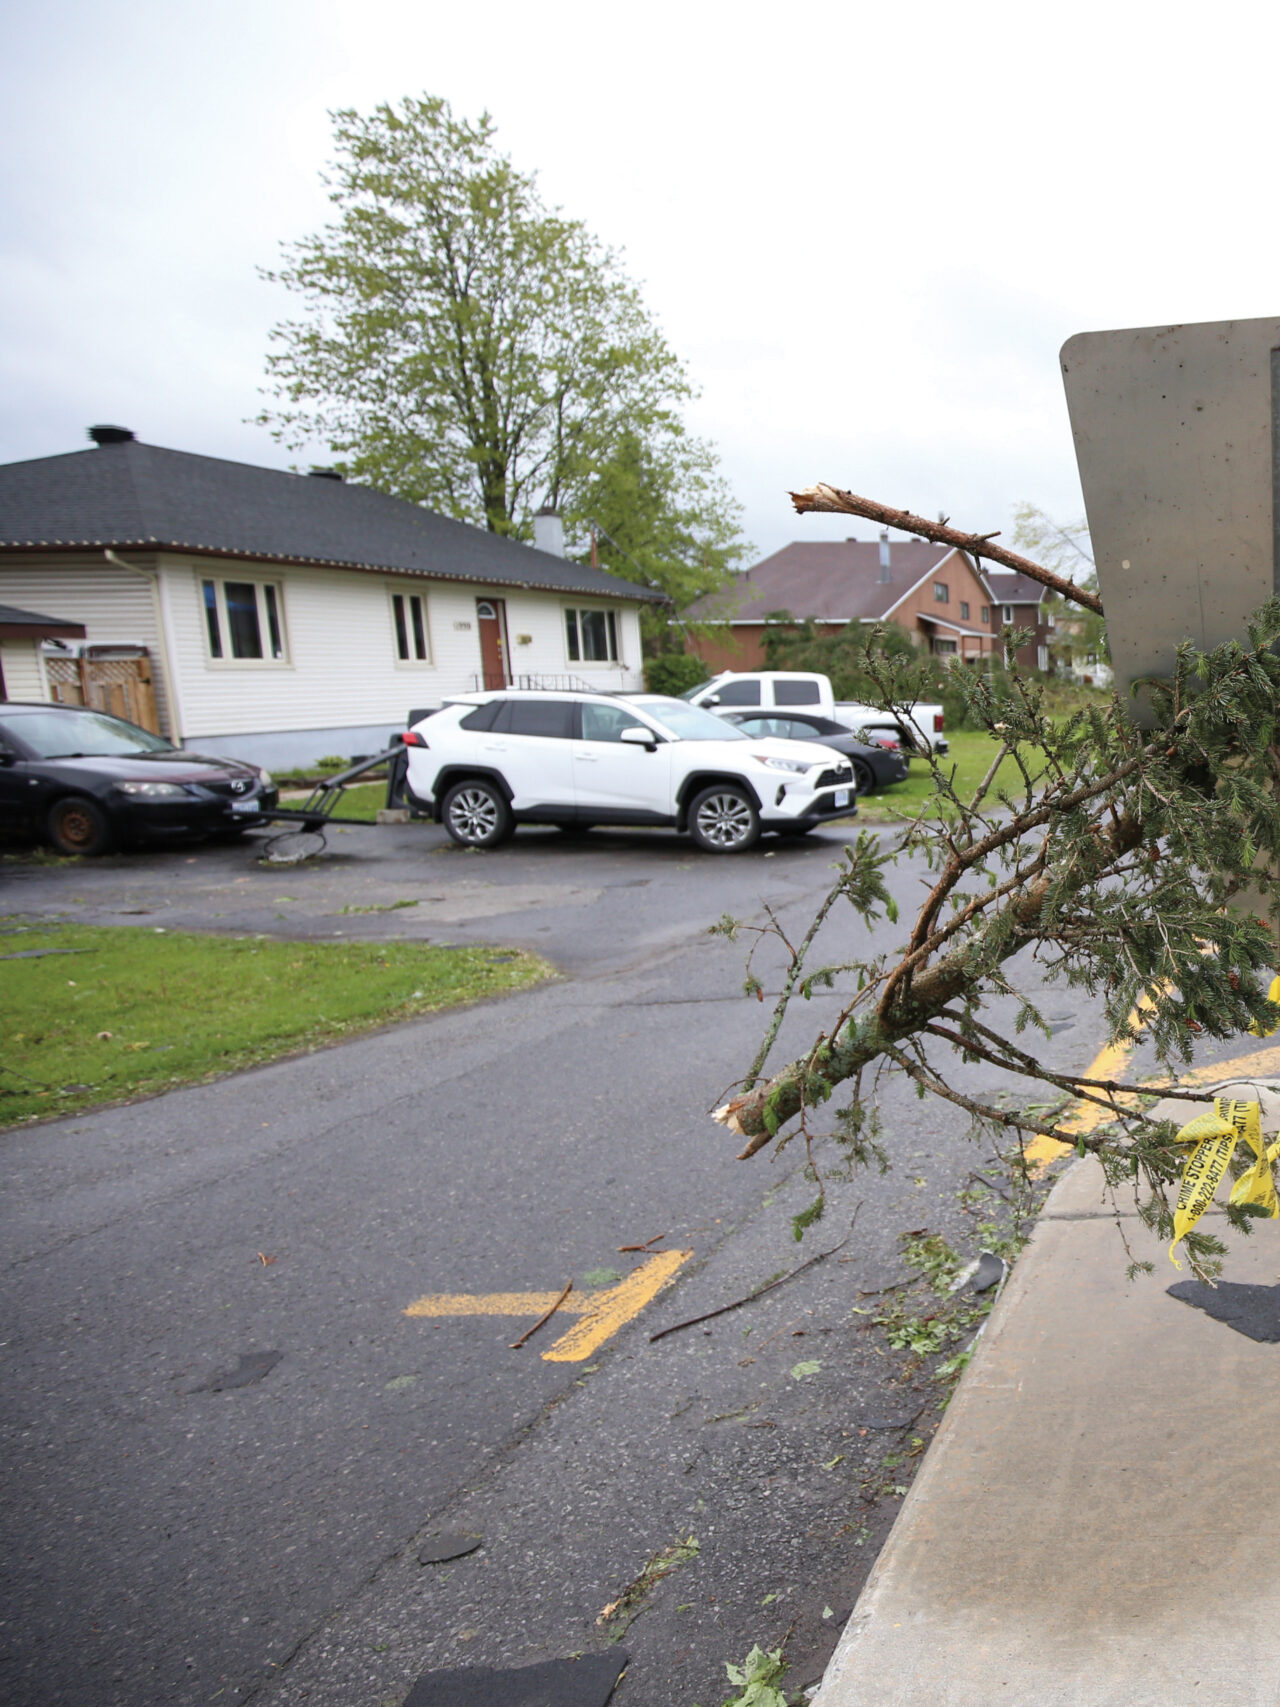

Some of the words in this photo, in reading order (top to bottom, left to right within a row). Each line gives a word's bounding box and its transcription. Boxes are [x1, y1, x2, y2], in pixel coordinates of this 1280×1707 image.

[1176, 1178, 1196, 1211] CRIME
[1186, 1135, 1218, 1181] STOPPER
[1187, 1159, 1224, 1222] 1-800-222-8477
[1215, 1132, 1234, 1161] (TIPS)
